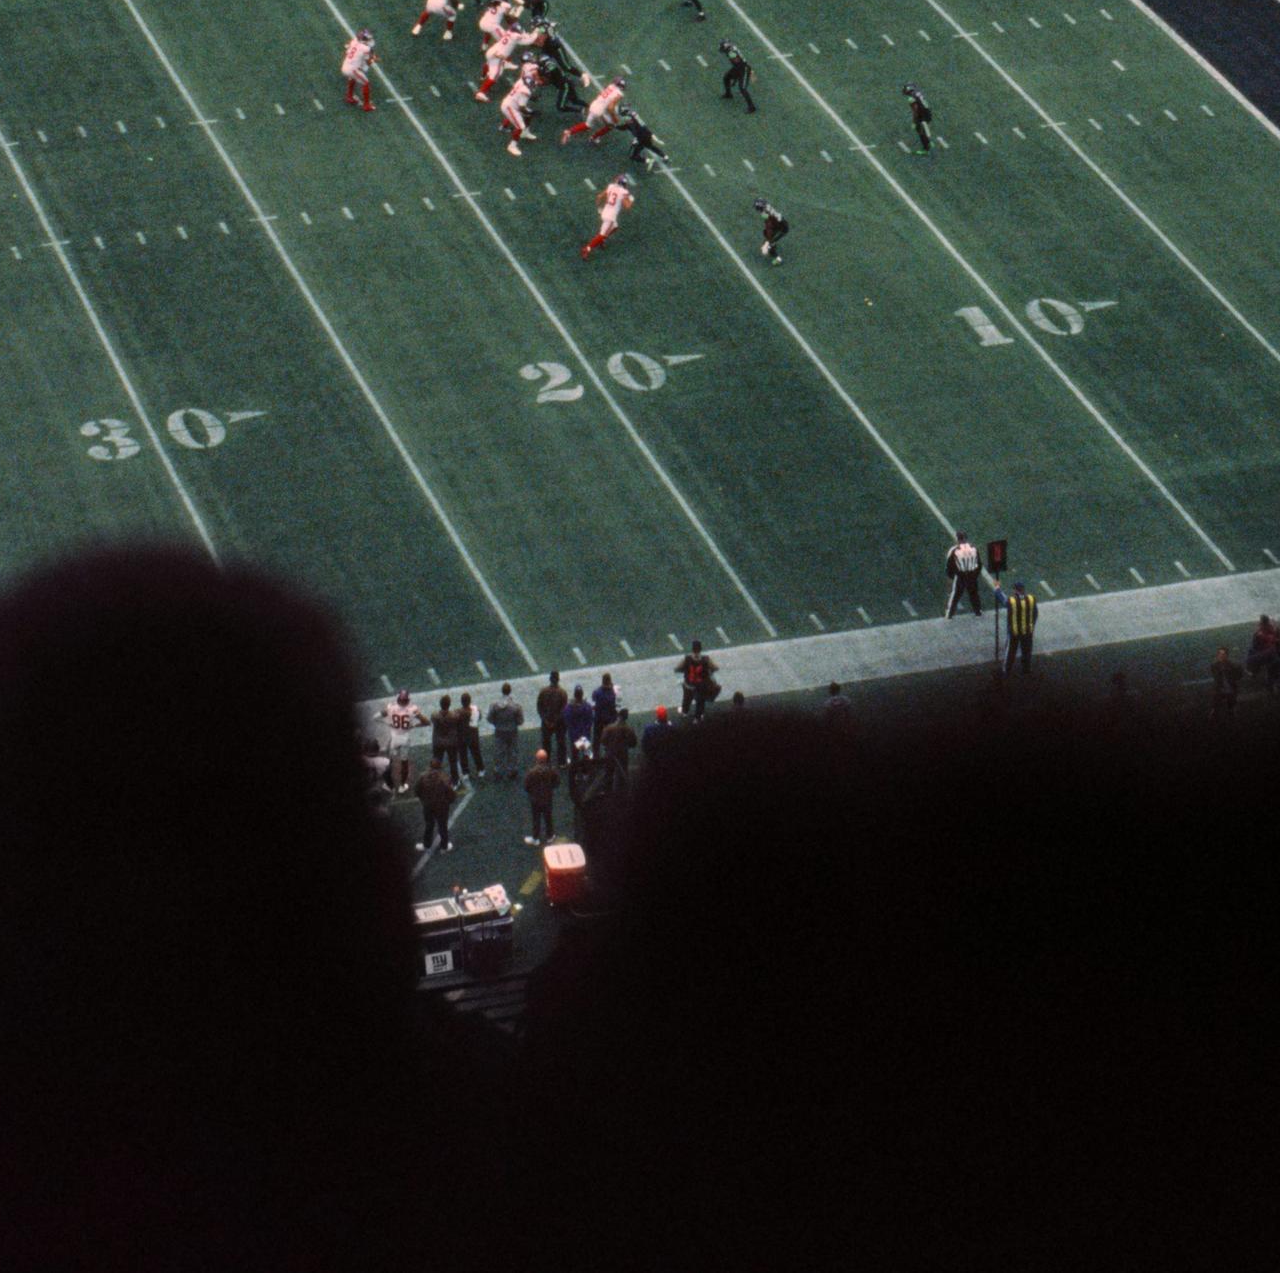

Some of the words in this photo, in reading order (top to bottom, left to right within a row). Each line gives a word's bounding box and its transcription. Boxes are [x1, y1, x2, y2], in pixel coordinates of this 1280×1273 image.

[952, 296, 1088, 348] 10
[520, 350, 668, 404] 20
[78, 407, 228, 462] 30
[391, 714, 410, 730] 86
